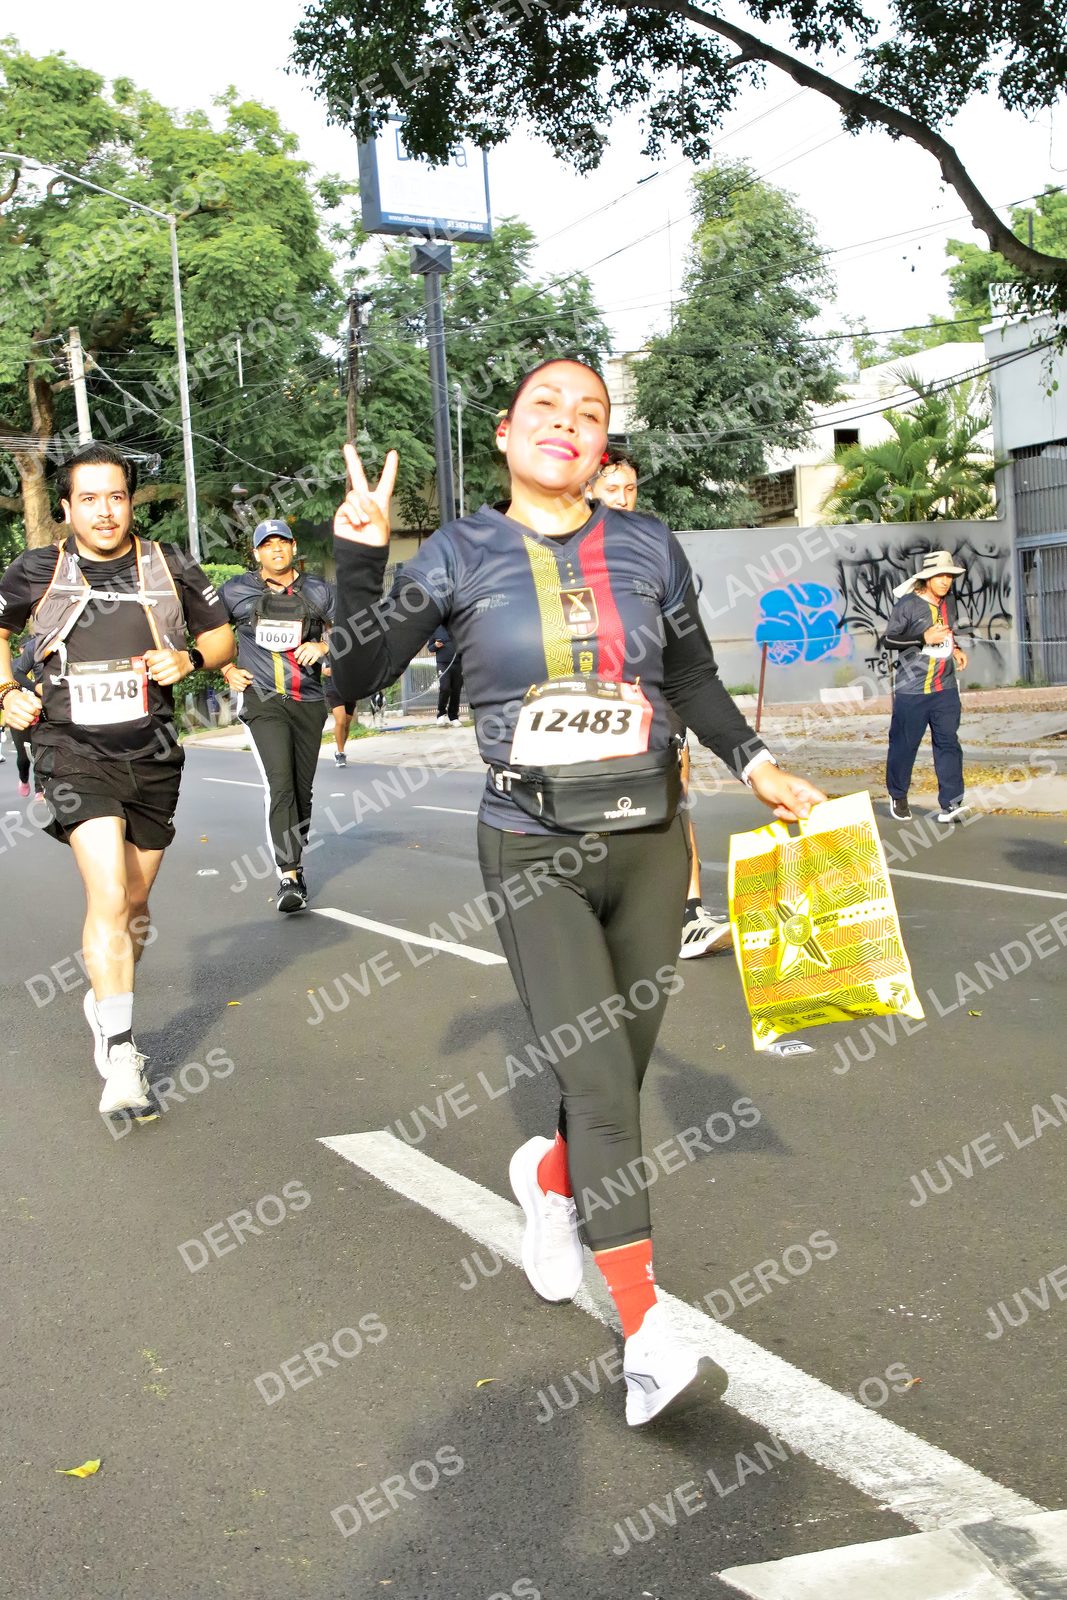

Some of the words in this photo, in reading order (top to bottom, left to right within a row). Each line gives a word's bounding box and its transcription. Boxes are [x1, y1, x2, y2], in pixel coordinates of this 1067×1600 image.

[259, 631, 295, 644] 10607
[74, 679, 138, 703] 11248
[529, 708, 632, 736] 12483
[813, 912, 839, 927] NEGROS
